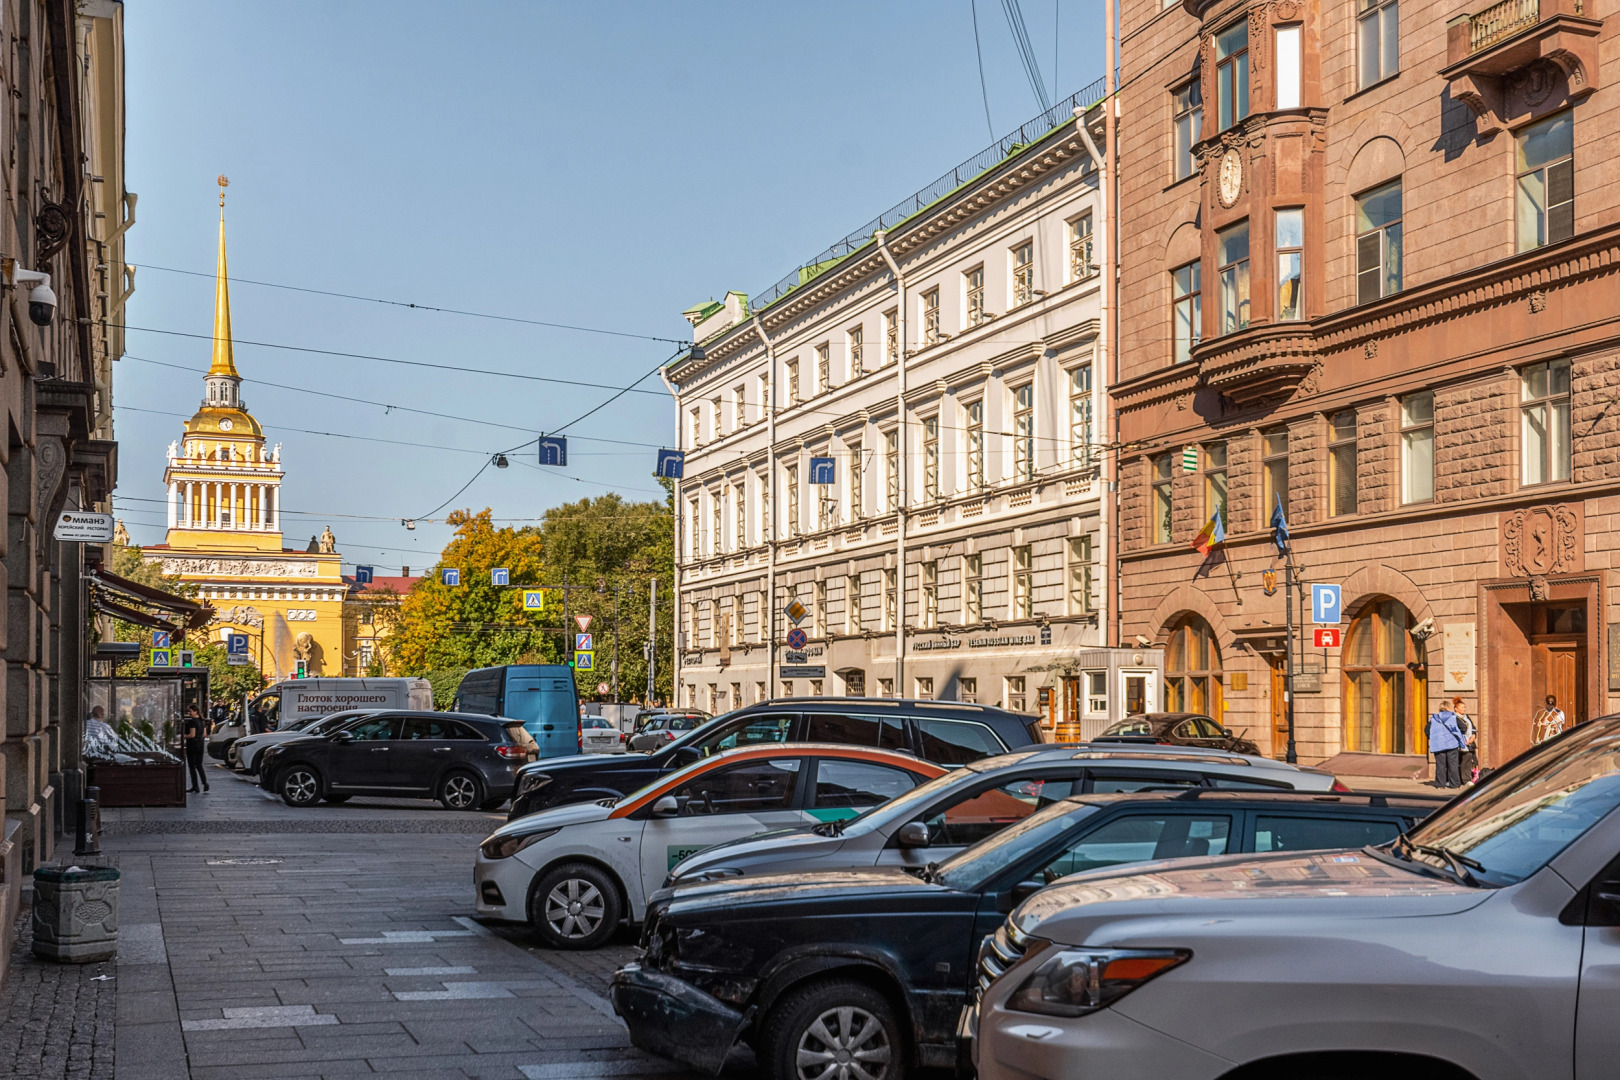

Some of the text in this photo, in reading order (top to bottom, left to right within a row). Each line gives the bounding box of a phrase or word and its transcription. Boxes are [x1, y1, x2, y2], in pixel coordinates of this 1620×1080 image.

[1320, 588, 1336, 619] P
[233, 636, 245, 652] P
[1023, 635, 1035, 645] BAR
[297, 693, 386, 705] Глоток хорошего
[297, 704, 358, 714] настроения
